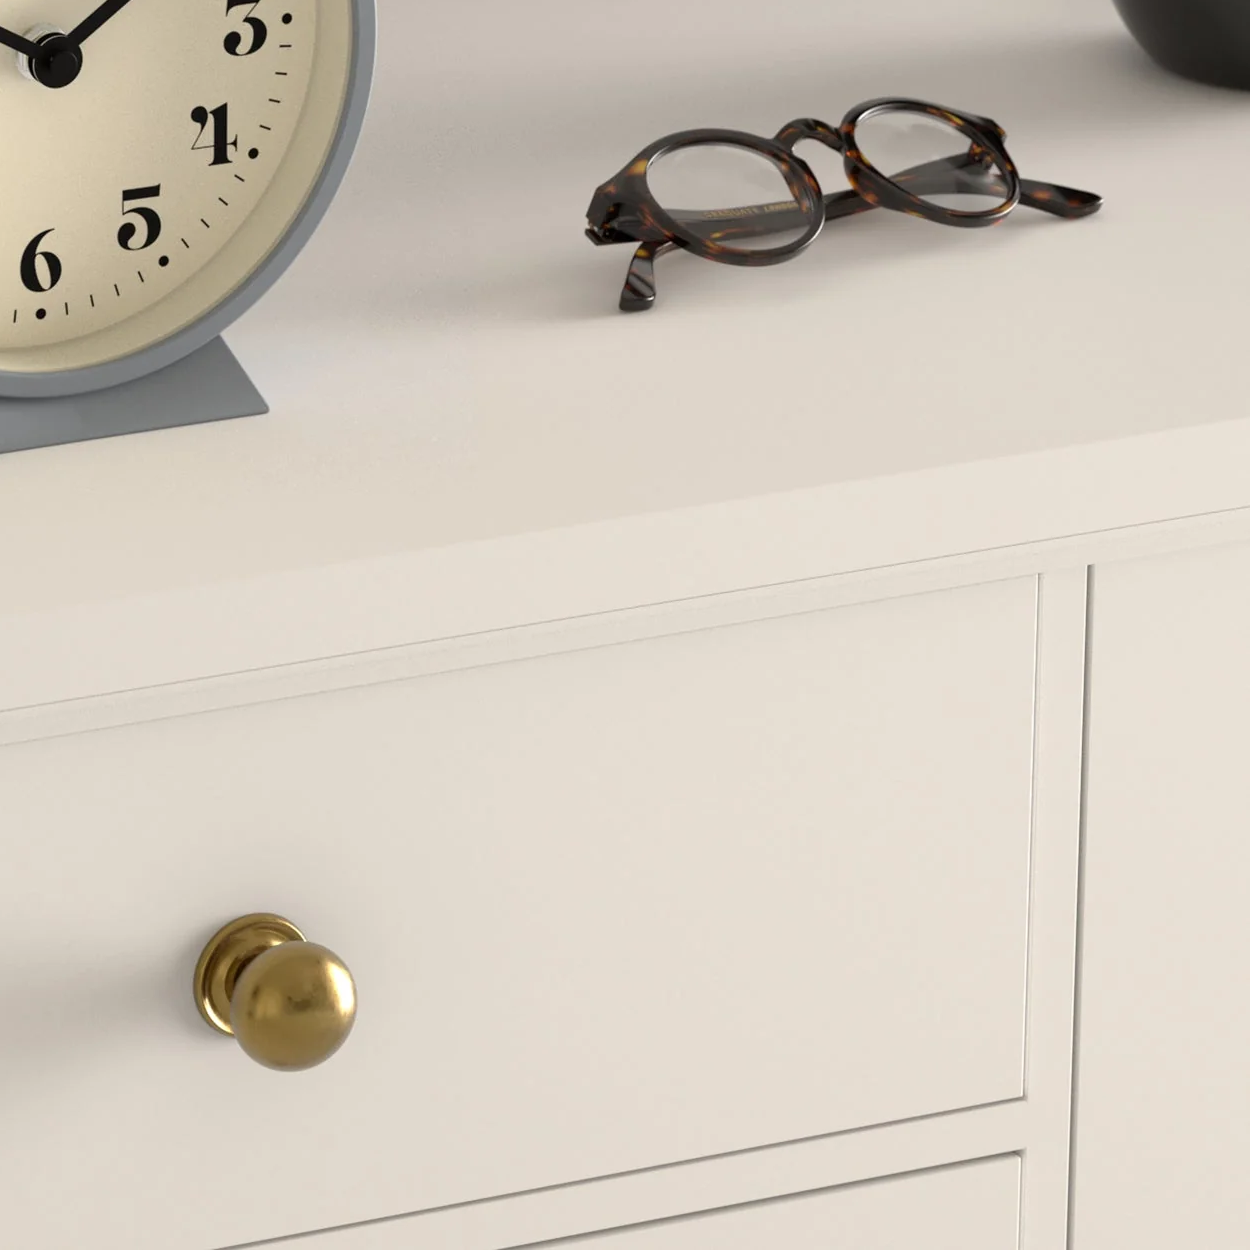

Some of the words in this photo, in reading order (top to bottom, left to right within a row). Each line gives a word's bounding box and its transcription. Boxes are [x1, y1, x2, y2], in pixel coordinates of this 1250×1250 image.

[190, 102, 238, 167] 4
[117, 183, 162, 251] 5
[20, 228, 62, 293] 6
